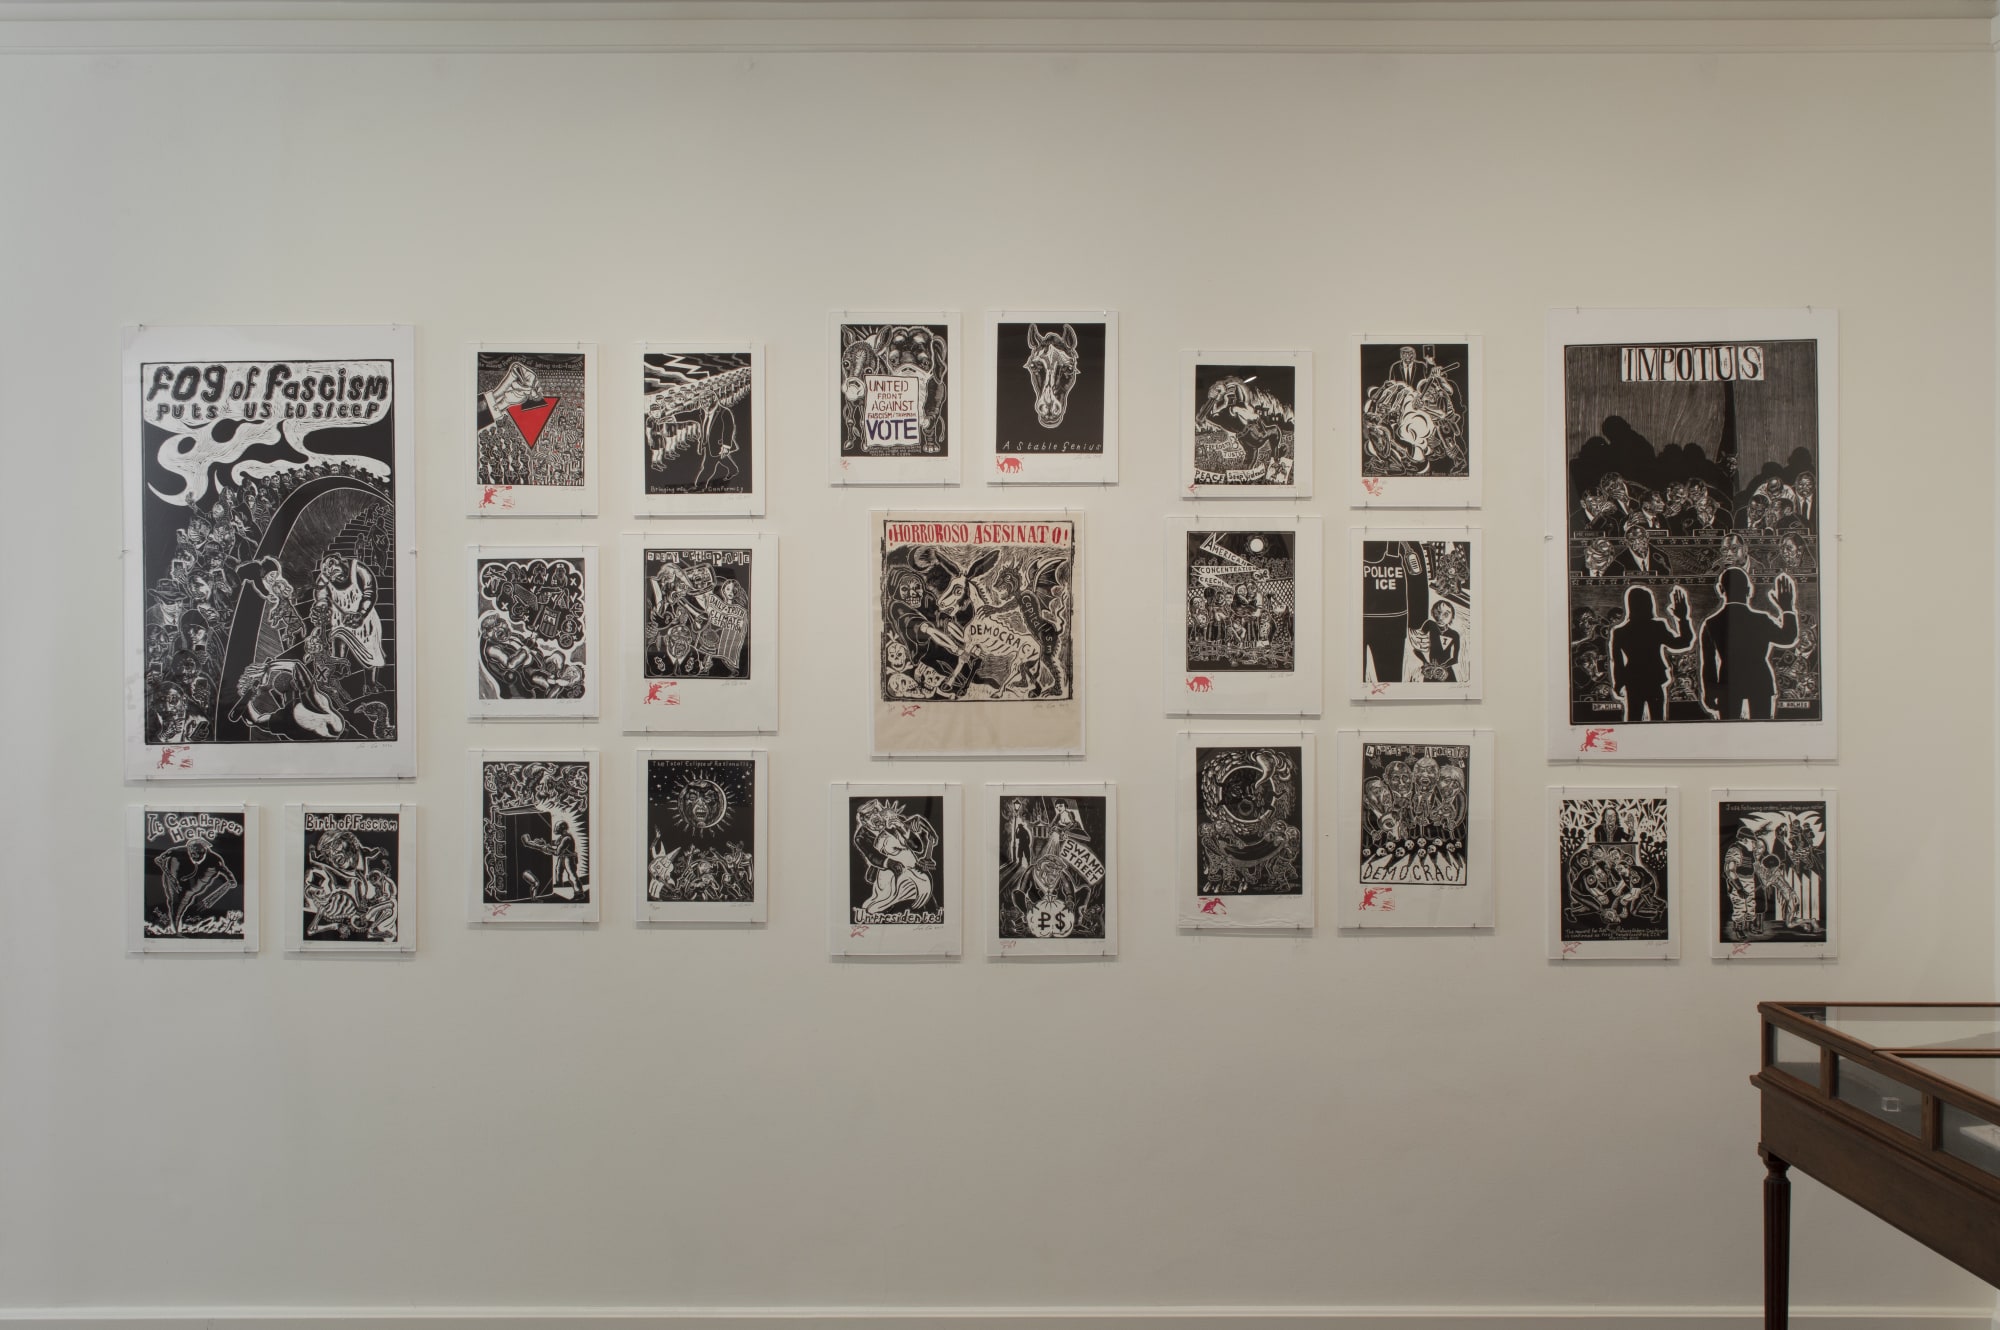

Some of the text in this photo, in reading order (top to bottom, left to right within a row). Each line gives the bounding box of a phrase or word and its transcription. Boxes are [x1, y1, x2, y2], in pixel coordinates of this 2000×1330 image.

[1623, 346, 1762, 380] IMPOTUS
[229, 365, 261, 400] of
[869, 380, 908, 392] UNITED
[156, 402, 220, 422] puts
[243, 402, 274, 420] us
[872, 400, 914, 411] AGAINST
[866, 418, 918, 440] VOTE
[1002, 440, 1102, 452] A Stable Genius
[974, 524, 1068, 547] ASESINATO!
[1204, 540, 1248, 566] AMERICAN
[1364, 566, 1402, 578] POLICE
[1376, 579, 1396, 590] ICE
[1021, 595, 1053, 654] Capitalism
[970, 624, 1038, 660] DEMOCRACY
[148, 813, 244, 840] It Can Happen
[306, 814, 398, 832] Birth of Fascism
[170, 827, 216, 843] Here
[1061, 848, 1098, 882] STREET
[1064, 840, 1105, 876] SWAMP
[1363, 862, 1460, 882] DEMOCRACY
[1055, 911, 1066, 931] $
